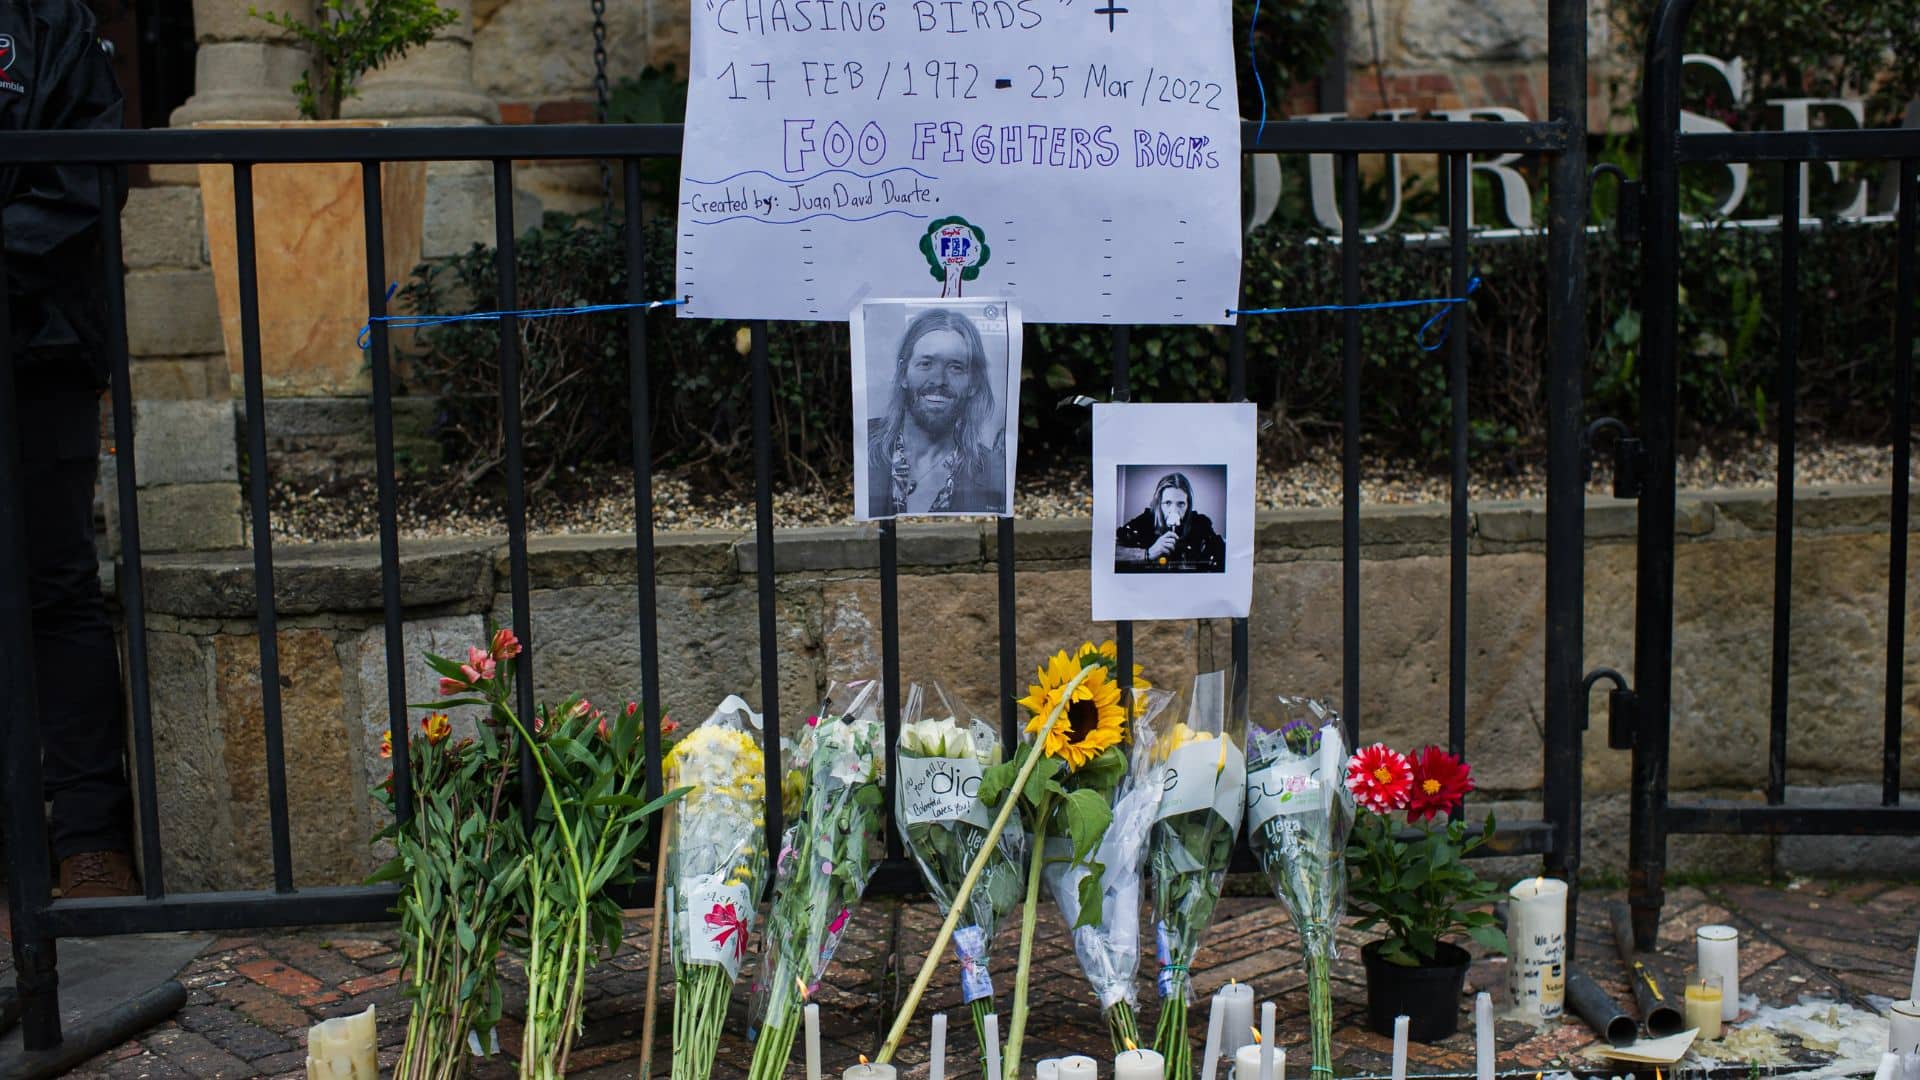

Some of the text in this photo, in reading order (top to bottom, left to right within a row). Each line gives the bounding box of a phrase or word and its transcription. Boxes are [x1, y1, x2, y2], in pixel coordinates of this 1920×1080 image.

[717, 61, 776, 100] 17
[1027, 64, 1069, 99] 25
[783, 119, 887, 173] FOO
[911, 121, 1120, 170] FIGHTERS
[788, 183, 832, 212] Juan
[833, 180, 873, 208] David
